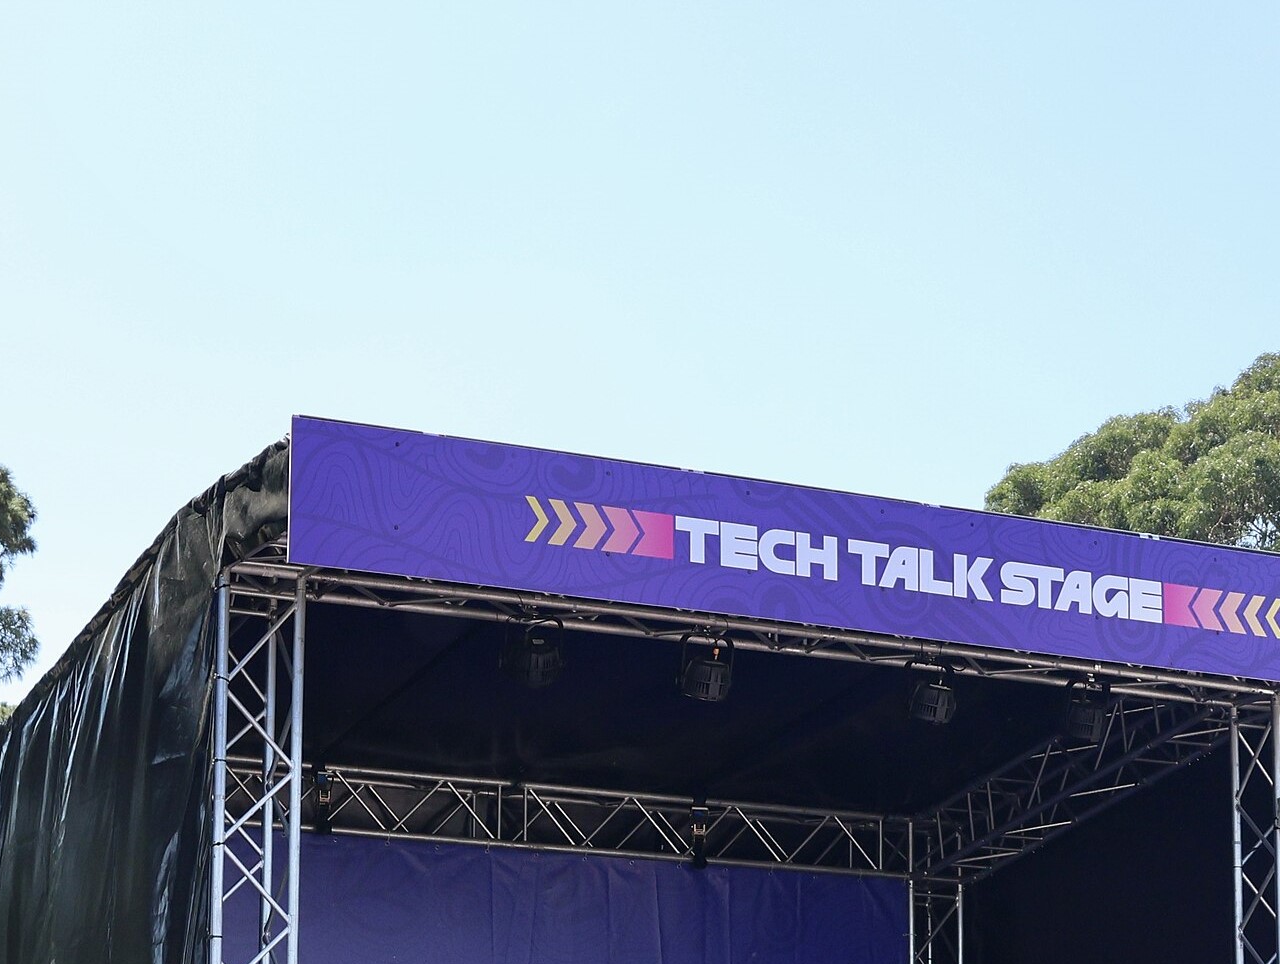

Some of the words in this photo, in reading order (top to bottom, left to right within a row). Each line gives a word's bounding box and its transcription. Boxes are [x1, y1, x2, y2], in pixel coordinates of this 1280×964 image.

[675, 515, 838, 581] TECH
[847, 538, 994, 602] TALK
[1000, 561, 1163, 624] STAGE
